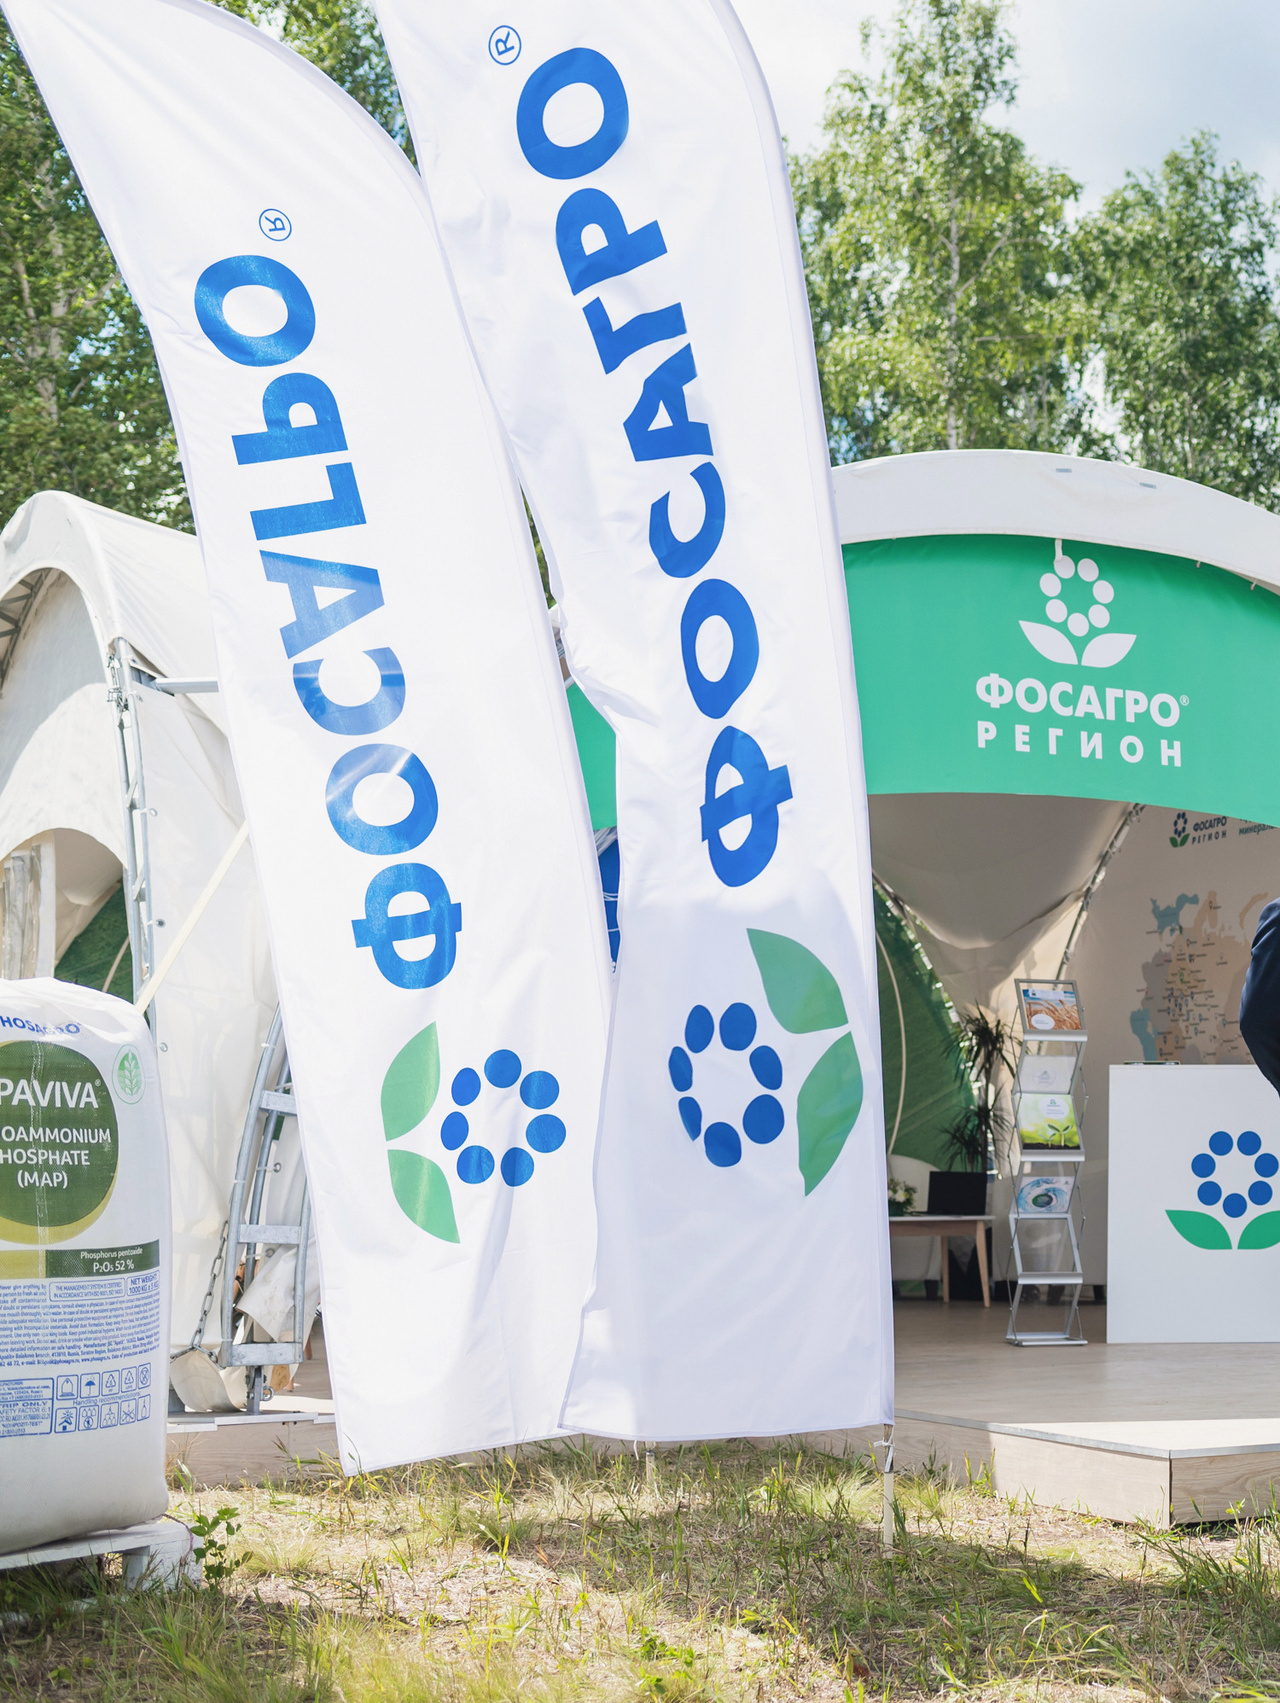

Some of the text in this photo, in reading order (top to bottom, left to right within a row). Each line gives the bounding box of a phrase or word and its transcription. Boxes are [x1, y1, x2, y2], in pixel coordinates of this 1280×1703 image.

[516, 46, 793, 887] ФОСАГРО
[975, 673, 1181, 728] ФОСАГРО
[977, 720, 1182, 767] РЕГИОН
[1193, 816, 1227, 832] ФОСАГРО
[1192, 830, 1227, 844] РЕГИОН
[17, 1170, 68, 1189] (MAP)
[81, 1247, 143, 1260] Phosphorus pentoxide
[115, 1260, 125, 1271] 52
